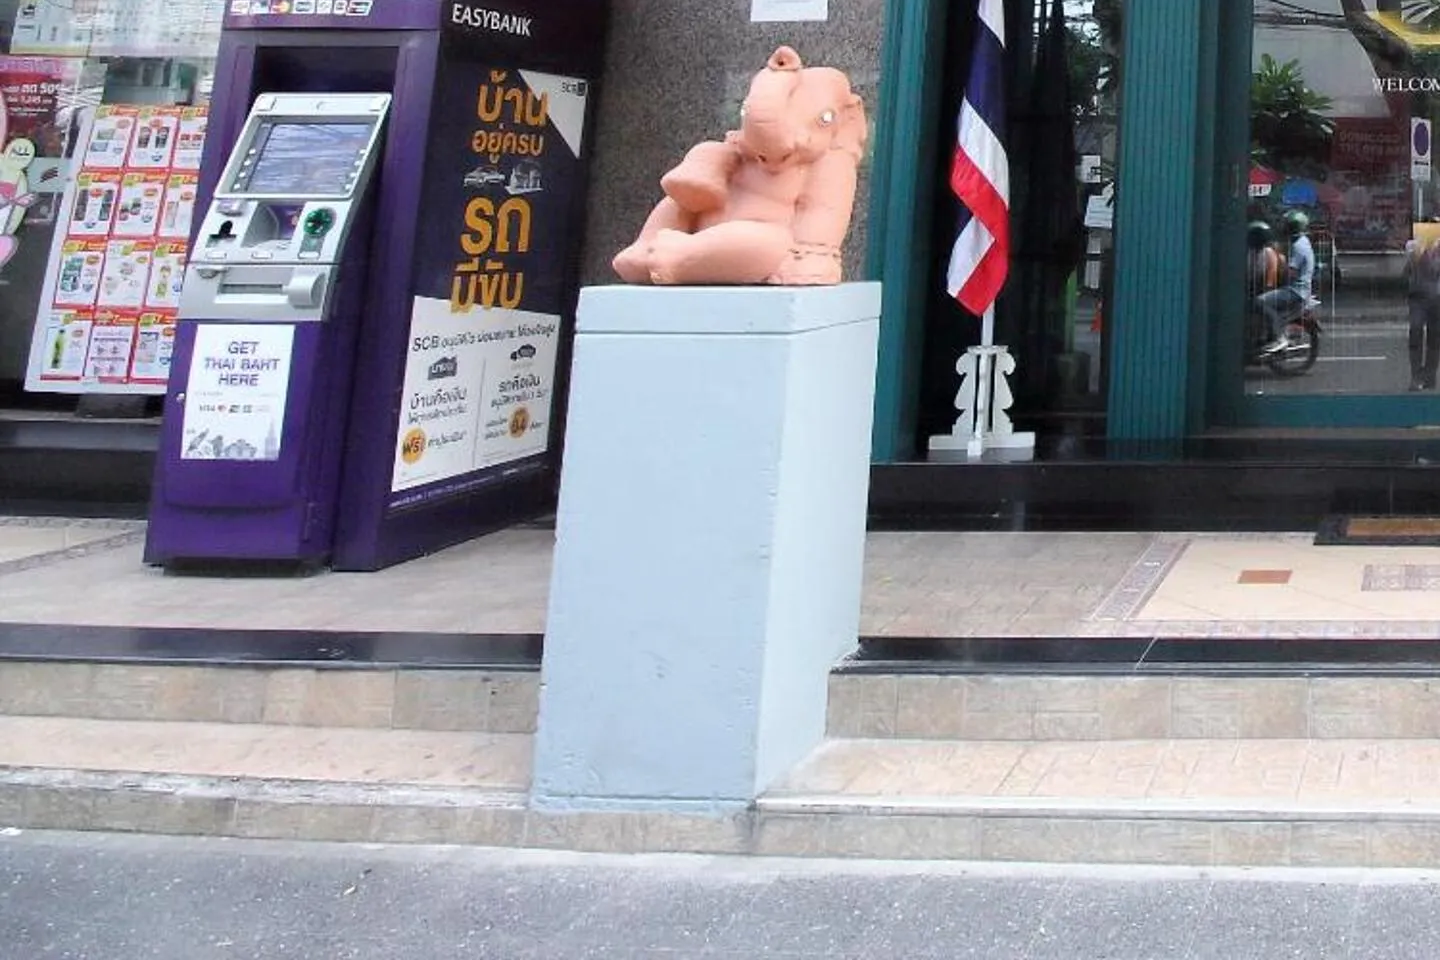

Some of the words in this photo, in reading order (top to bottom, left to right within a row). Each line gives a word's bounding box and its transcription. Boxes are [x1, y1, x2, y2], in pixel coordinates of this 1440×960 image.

[452, 3, 532, 37] EASYBANK
[477, 69, 548, 127] บ้าน
[472, 123, 543, 163] อยู่ครบ
[451, 257, 523, 313] มีขับ
[228, 341, 259, 355] GET
[413, 336, 439, 351] SCB
[204, 358, 235, 370] THAI
[240, 358, 280, 371] BAHT
[218, 374, 259, 387] HERE
